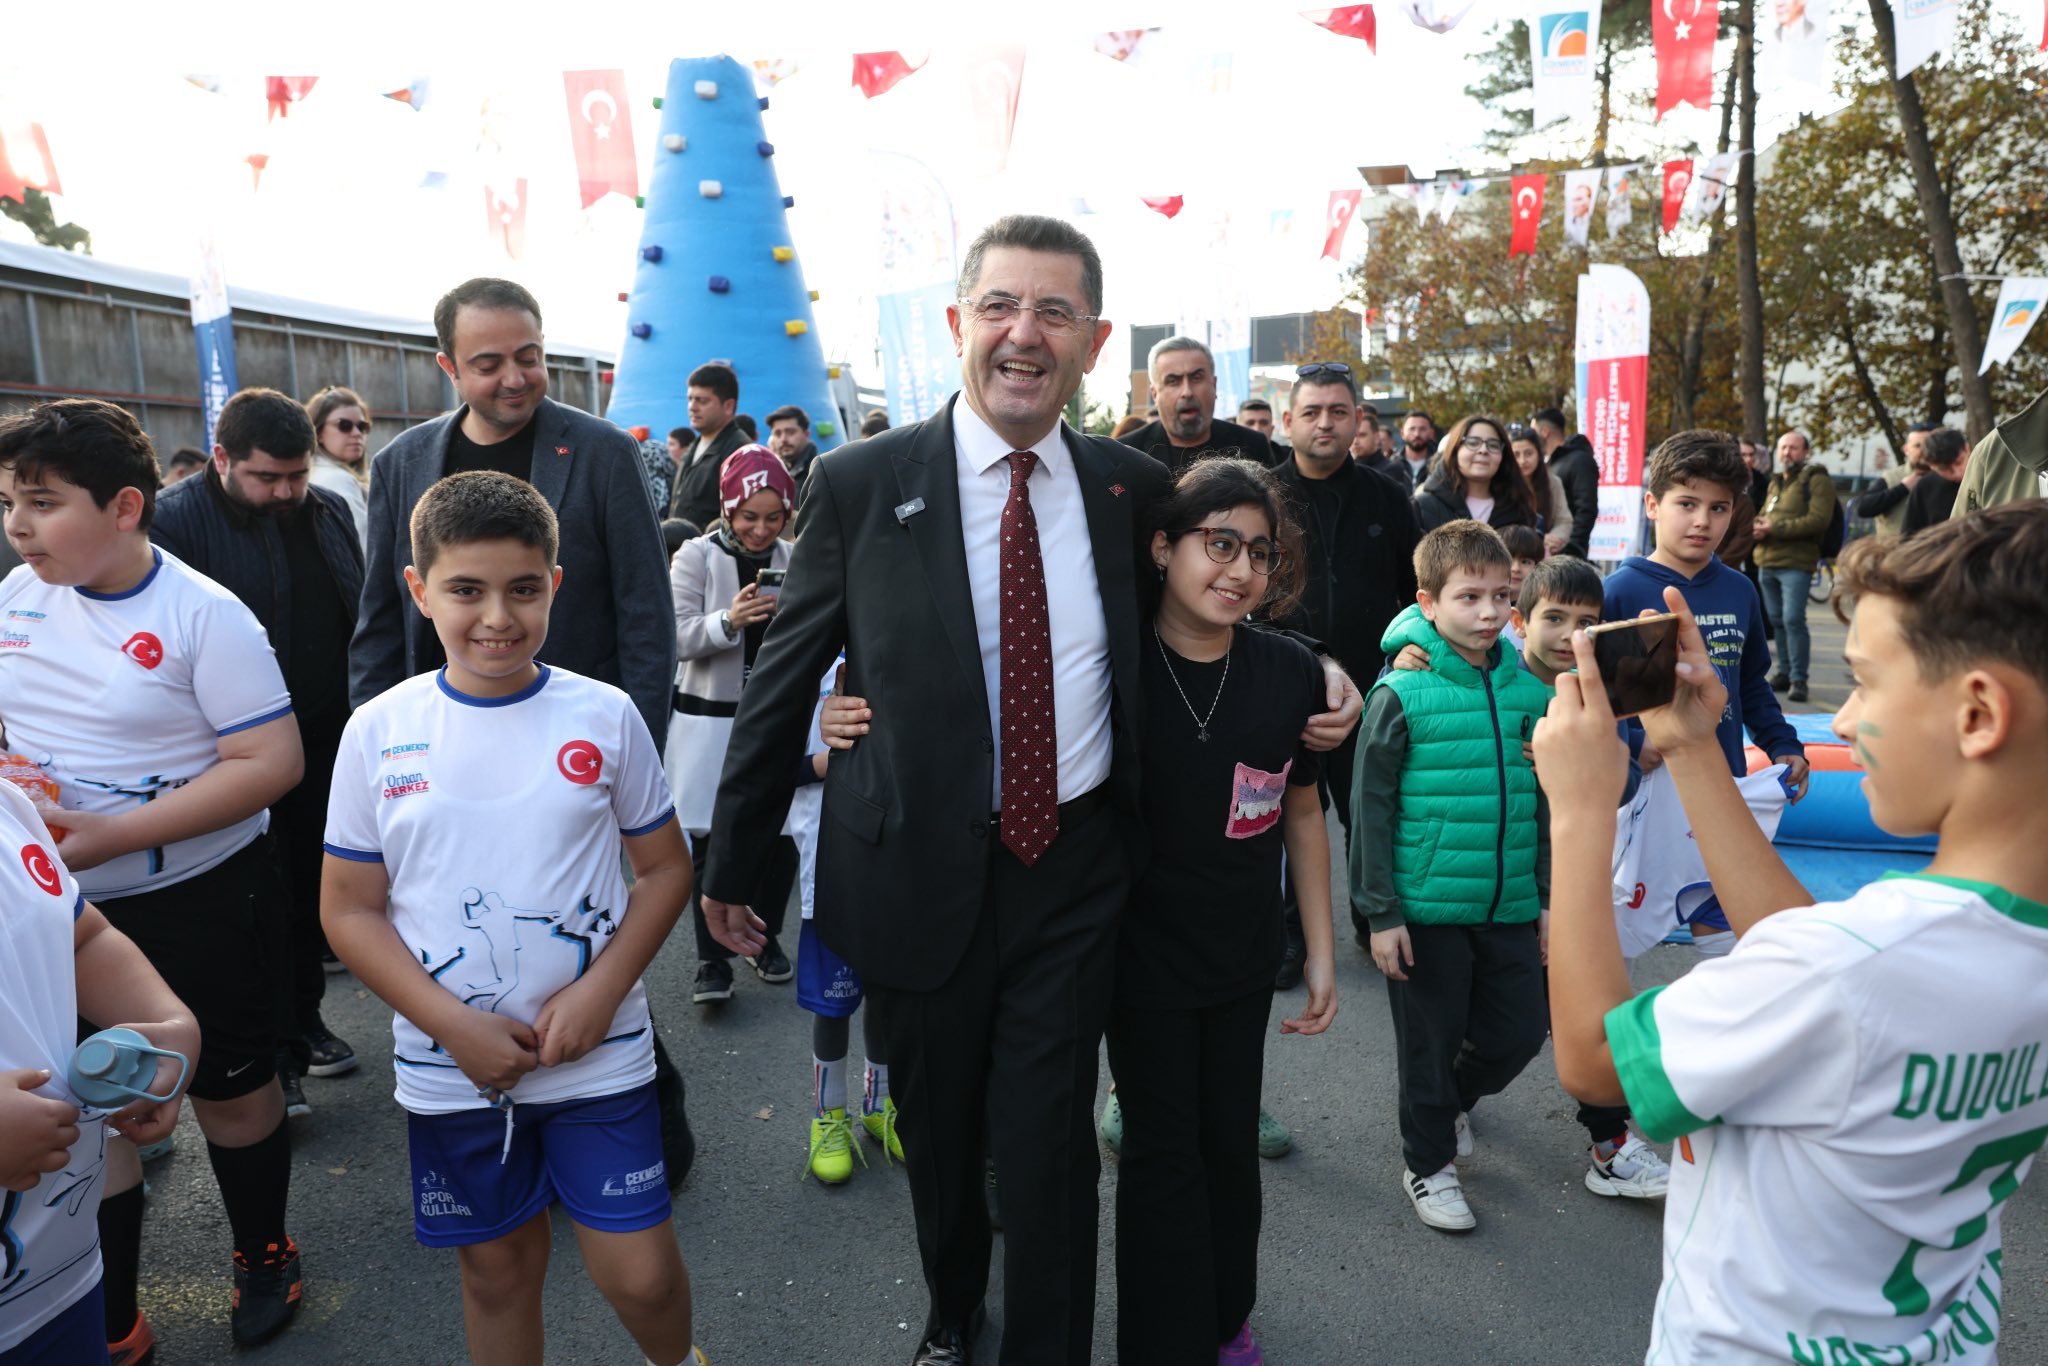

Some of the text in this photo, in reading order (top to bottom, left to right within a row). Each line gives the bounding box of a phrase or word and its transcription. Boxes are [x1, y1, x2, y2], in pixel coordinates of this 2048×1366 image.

[385, 772, 424, 787] Orhan
[384, 781, 430, 800] ÇERKEZ
[832, 980, 854, 990] SPOR
[421, 1191, 455, 1204] SPOR
